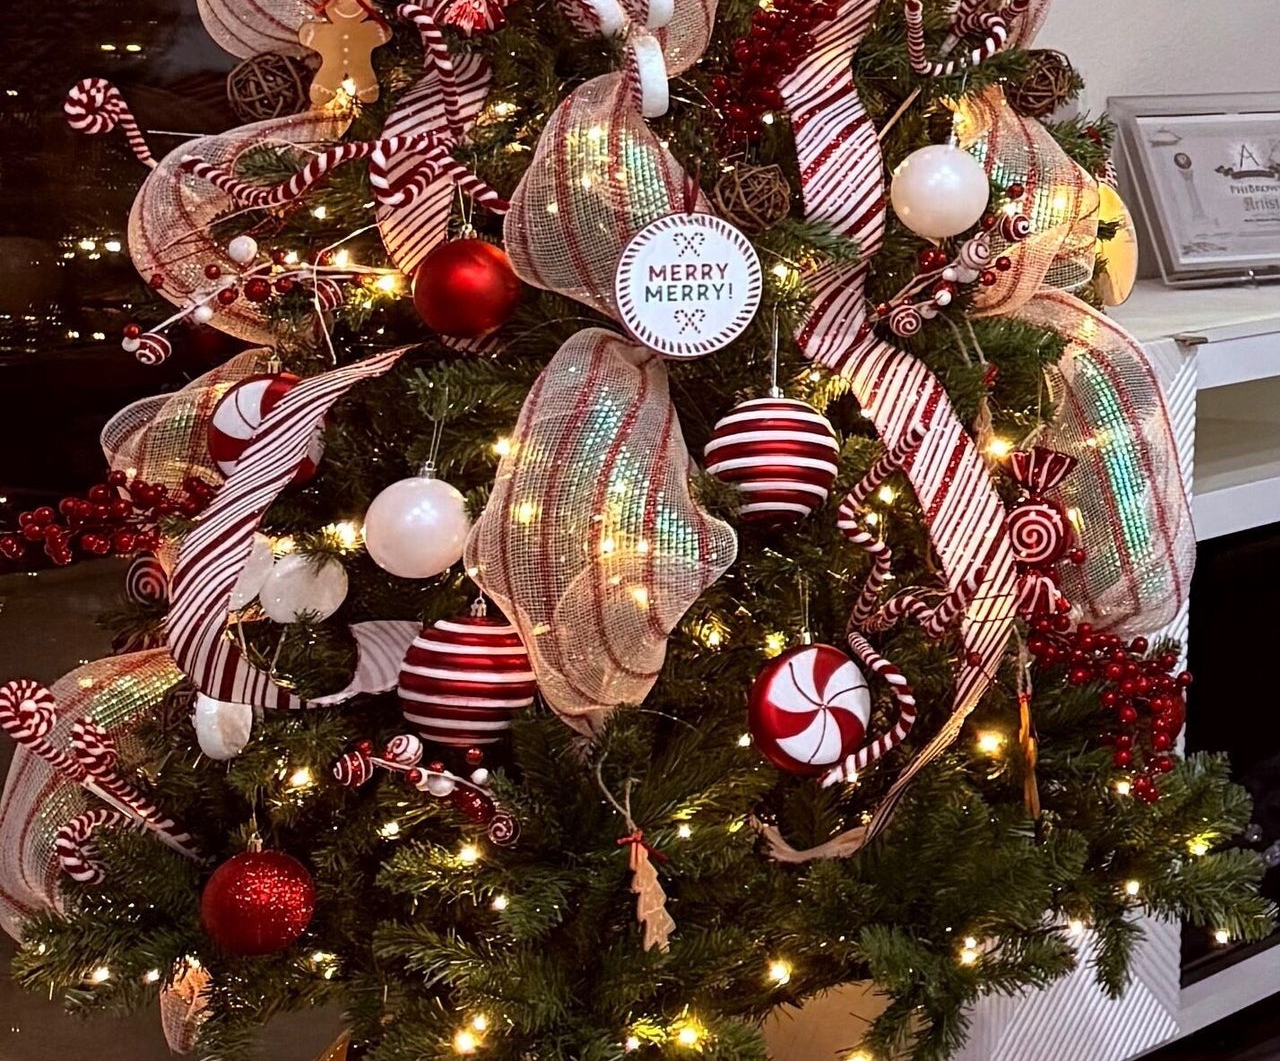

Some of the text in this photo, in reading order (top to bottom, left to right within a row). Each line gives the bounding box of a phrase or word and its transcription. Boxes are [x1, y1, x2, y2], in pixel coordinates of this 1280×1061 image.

[1243, 197, 1280, 211] Artist
[648, 263, 729, 283] MERRY
[645, 283, 734, 303] MERRY!
